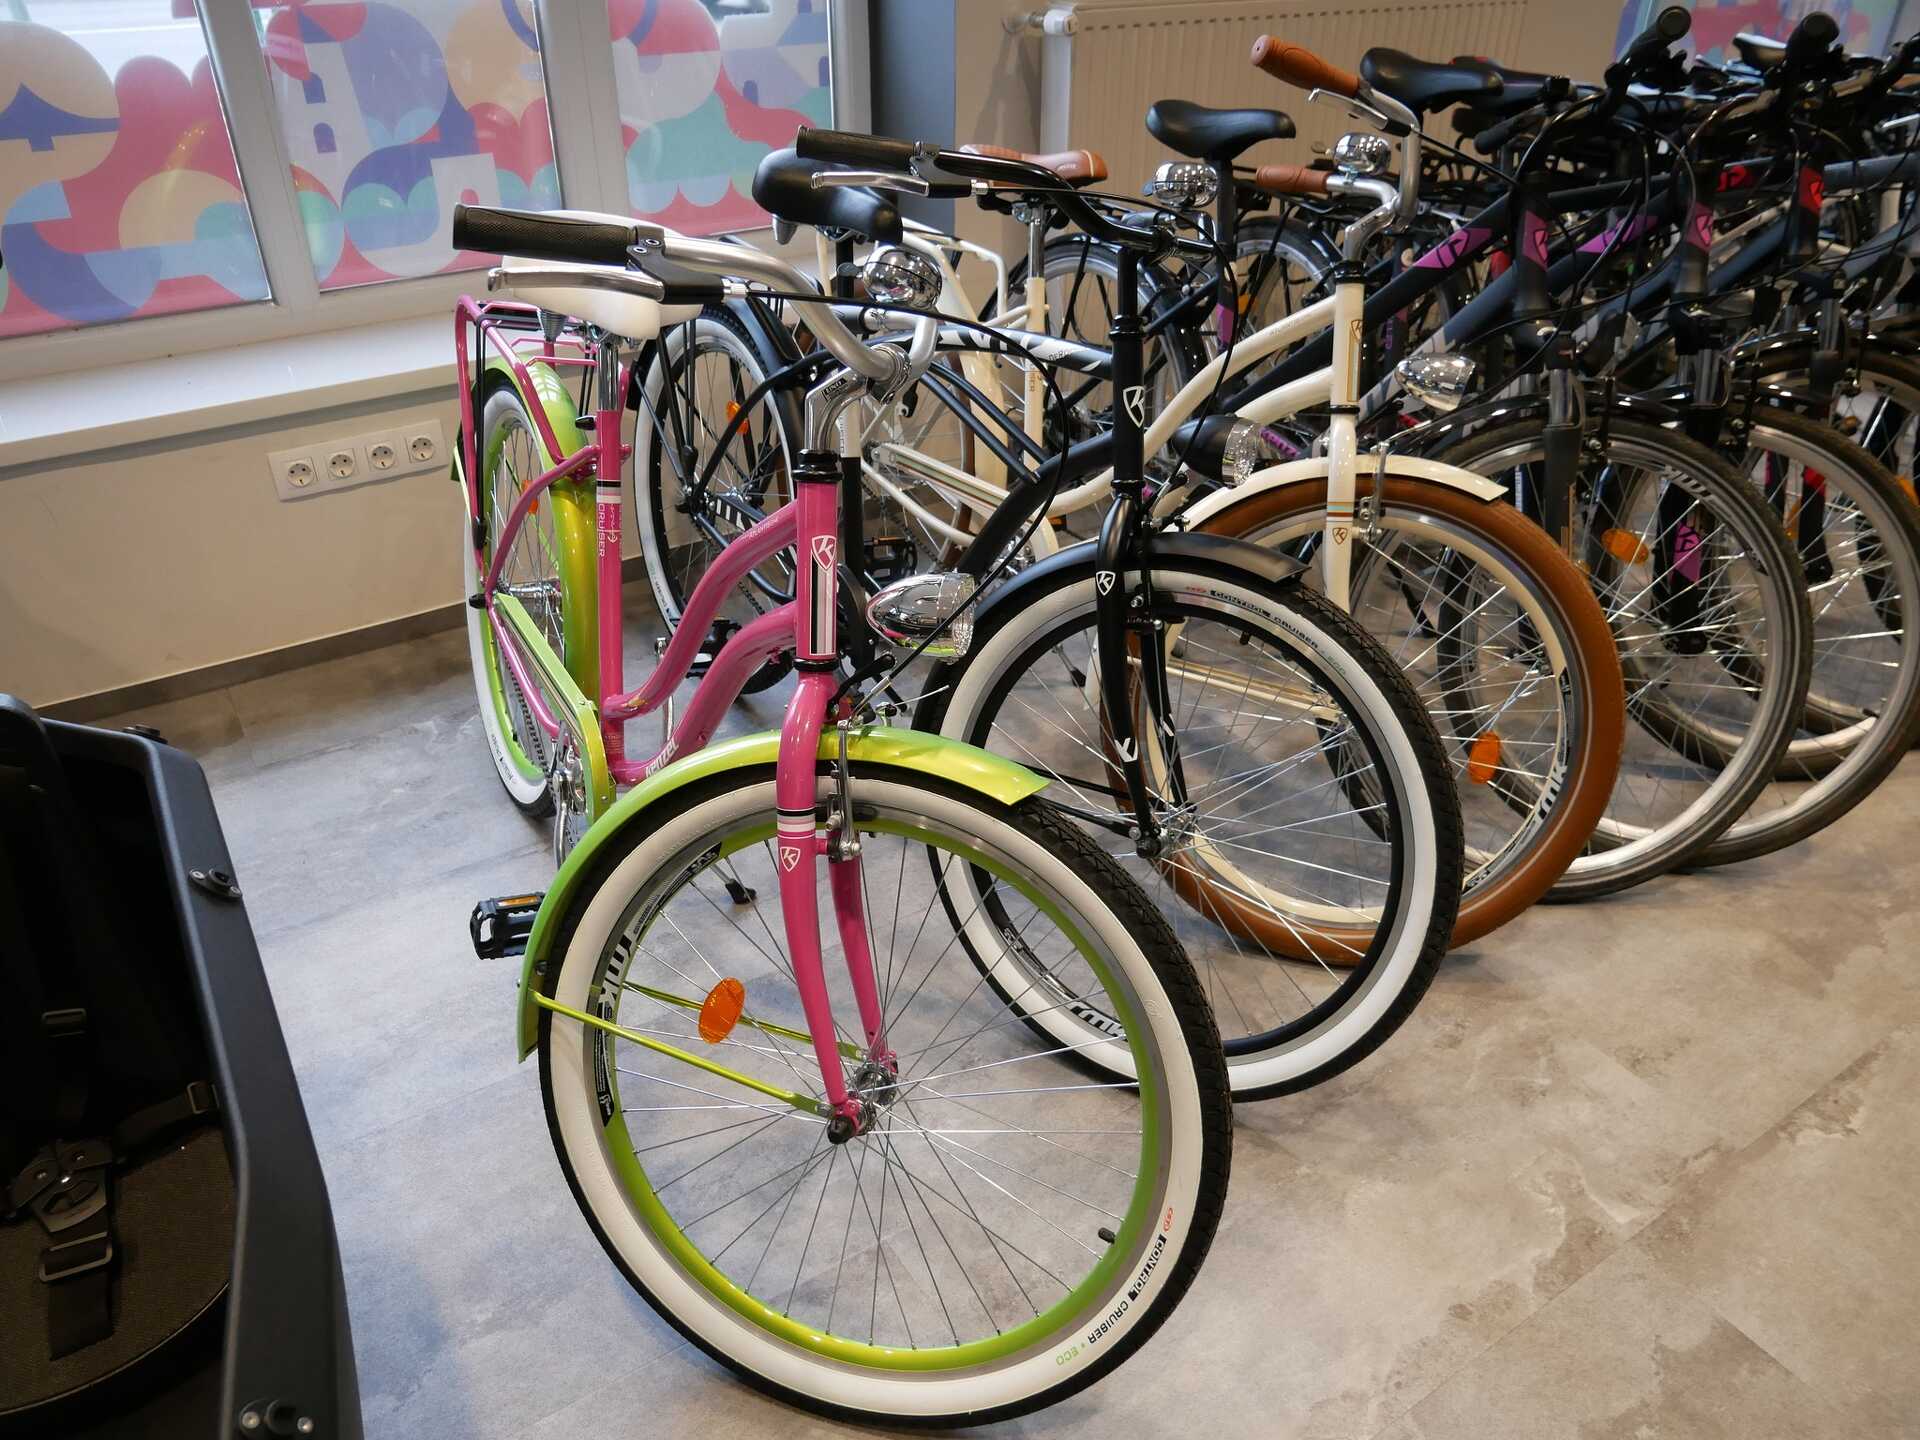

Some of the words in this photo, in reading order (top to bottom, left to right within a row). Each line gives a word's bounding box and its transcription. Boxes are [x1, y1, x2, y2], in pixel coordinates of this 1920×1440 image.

[1127, 1233, 1167, 1301] CONTROL
[1087, 1300, 1129, 1344] CRUISER
[1055, 1344, 1079, 1366] ECO
